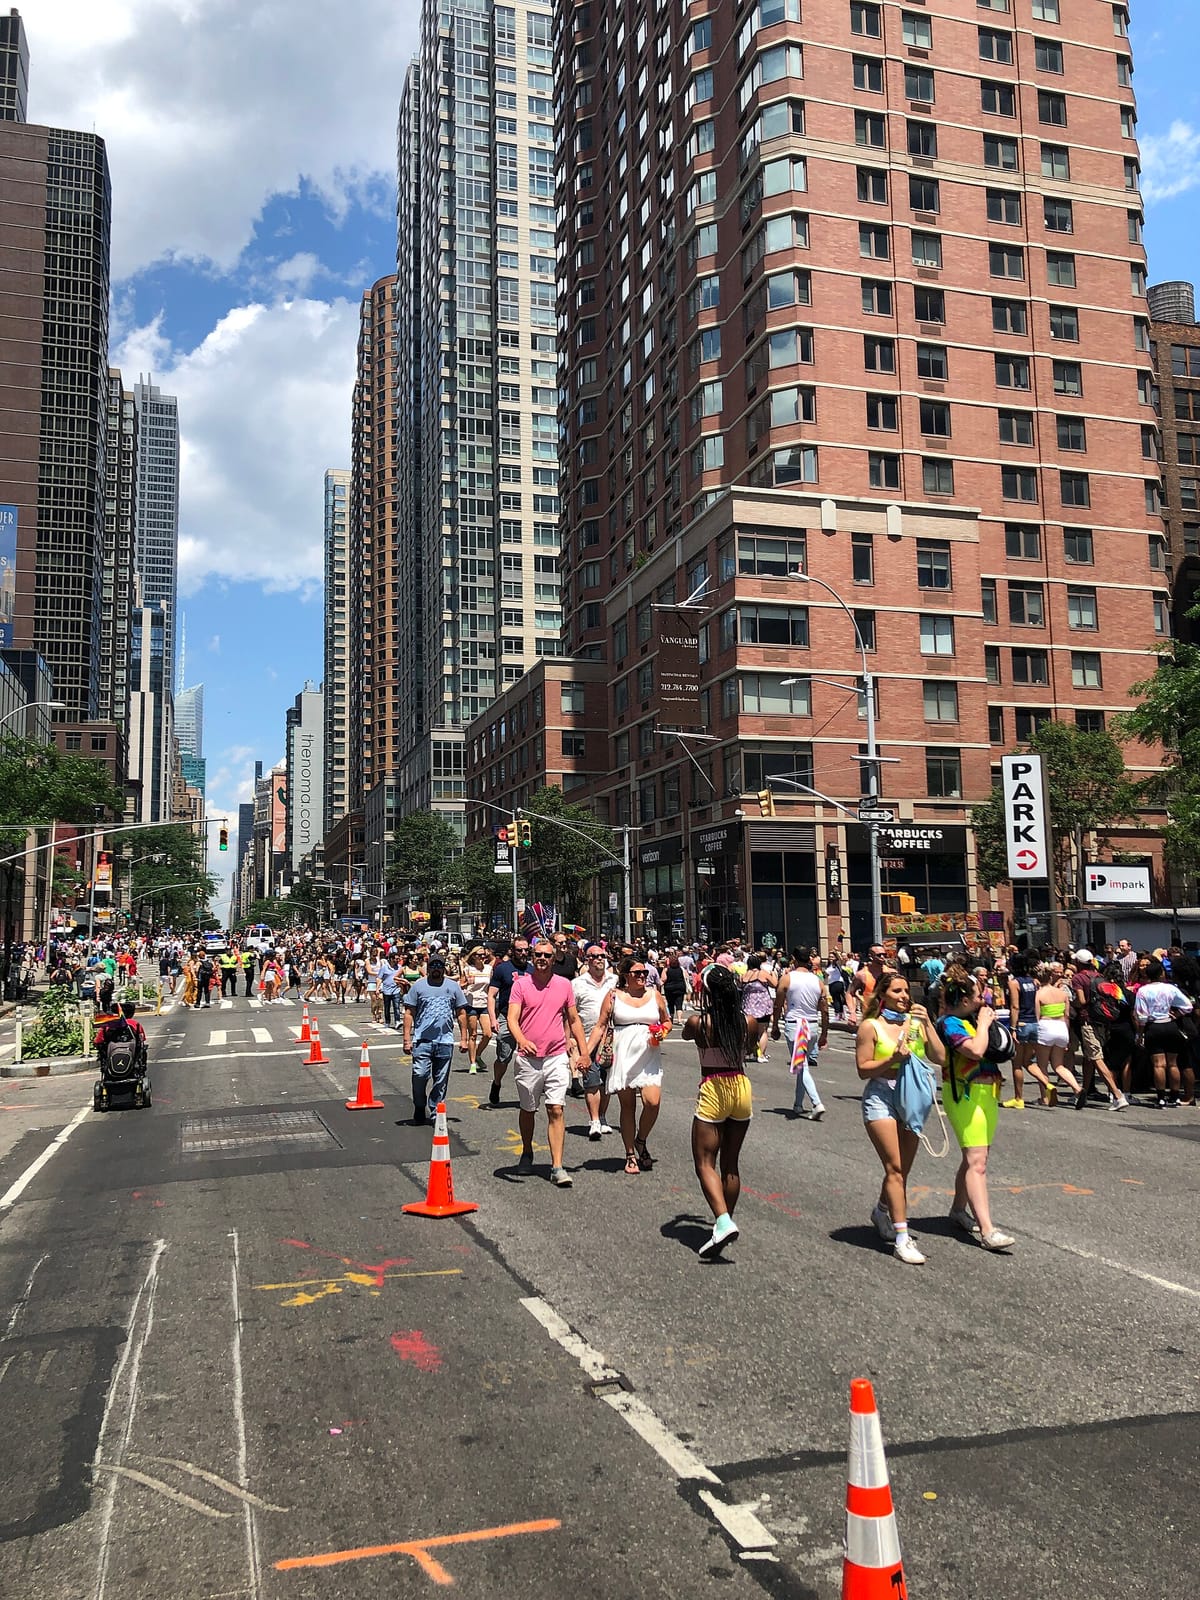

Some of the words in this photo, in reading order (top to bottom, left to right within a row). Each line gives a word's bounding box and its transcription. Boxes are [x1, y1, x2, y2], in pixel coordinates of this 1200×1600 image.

[660, 635, 698, 645] VANGUARD
[301, 734, 315, 844] thenoma.com
[1011, 763, 1037, 843] PARK
[700, 830, 727, 844] STARBUCKS
[876, 829, 943, 839] TARBUCKS
[705, 841, 722, 852] COFFEE
[642, 850, 660, 863] verizon
[830, 865, 839, 886] PARK
[1109, 880, 1145, 891] impark
